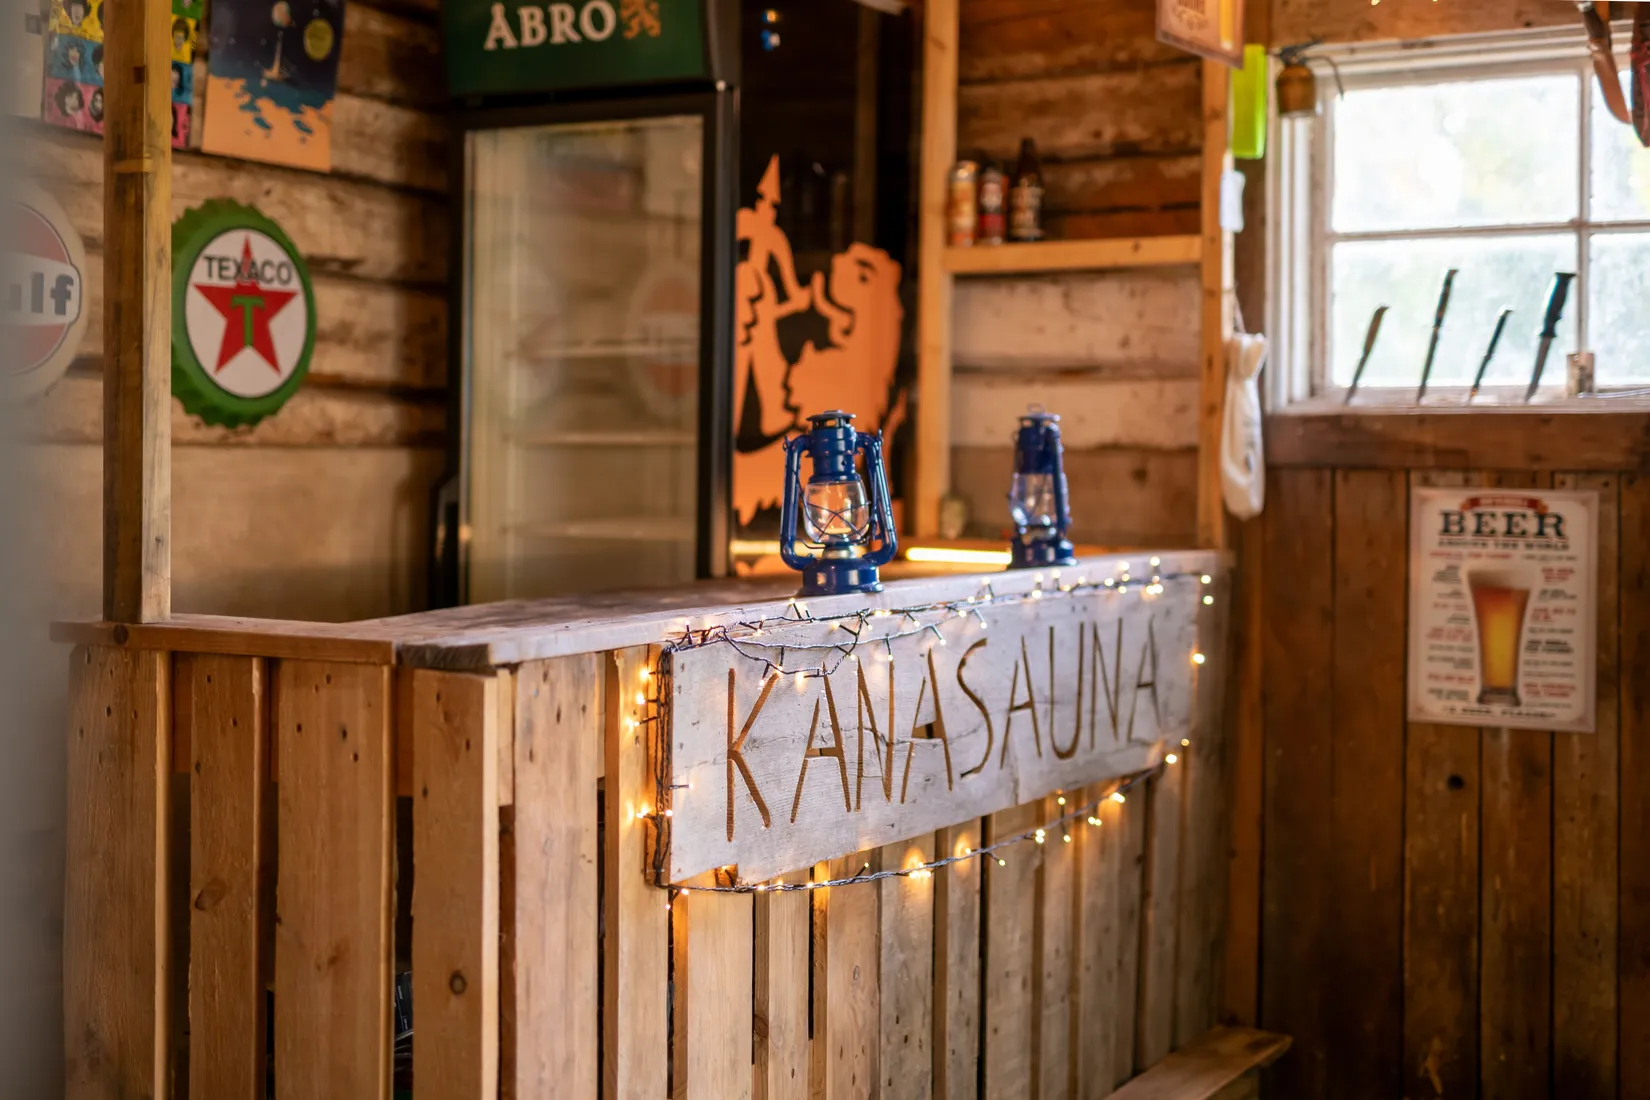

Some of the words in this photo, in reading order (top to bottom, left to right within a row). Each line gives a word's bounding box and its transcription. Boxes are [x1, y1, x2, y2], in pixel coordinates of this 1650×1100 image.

[484, 0, 616, 50] ÅBRO
[203, 255, 293, 286] TEXACO
[1438, 510, 1567, 539] BEER
[727, 614, 1161, 842] KANASAUNA
